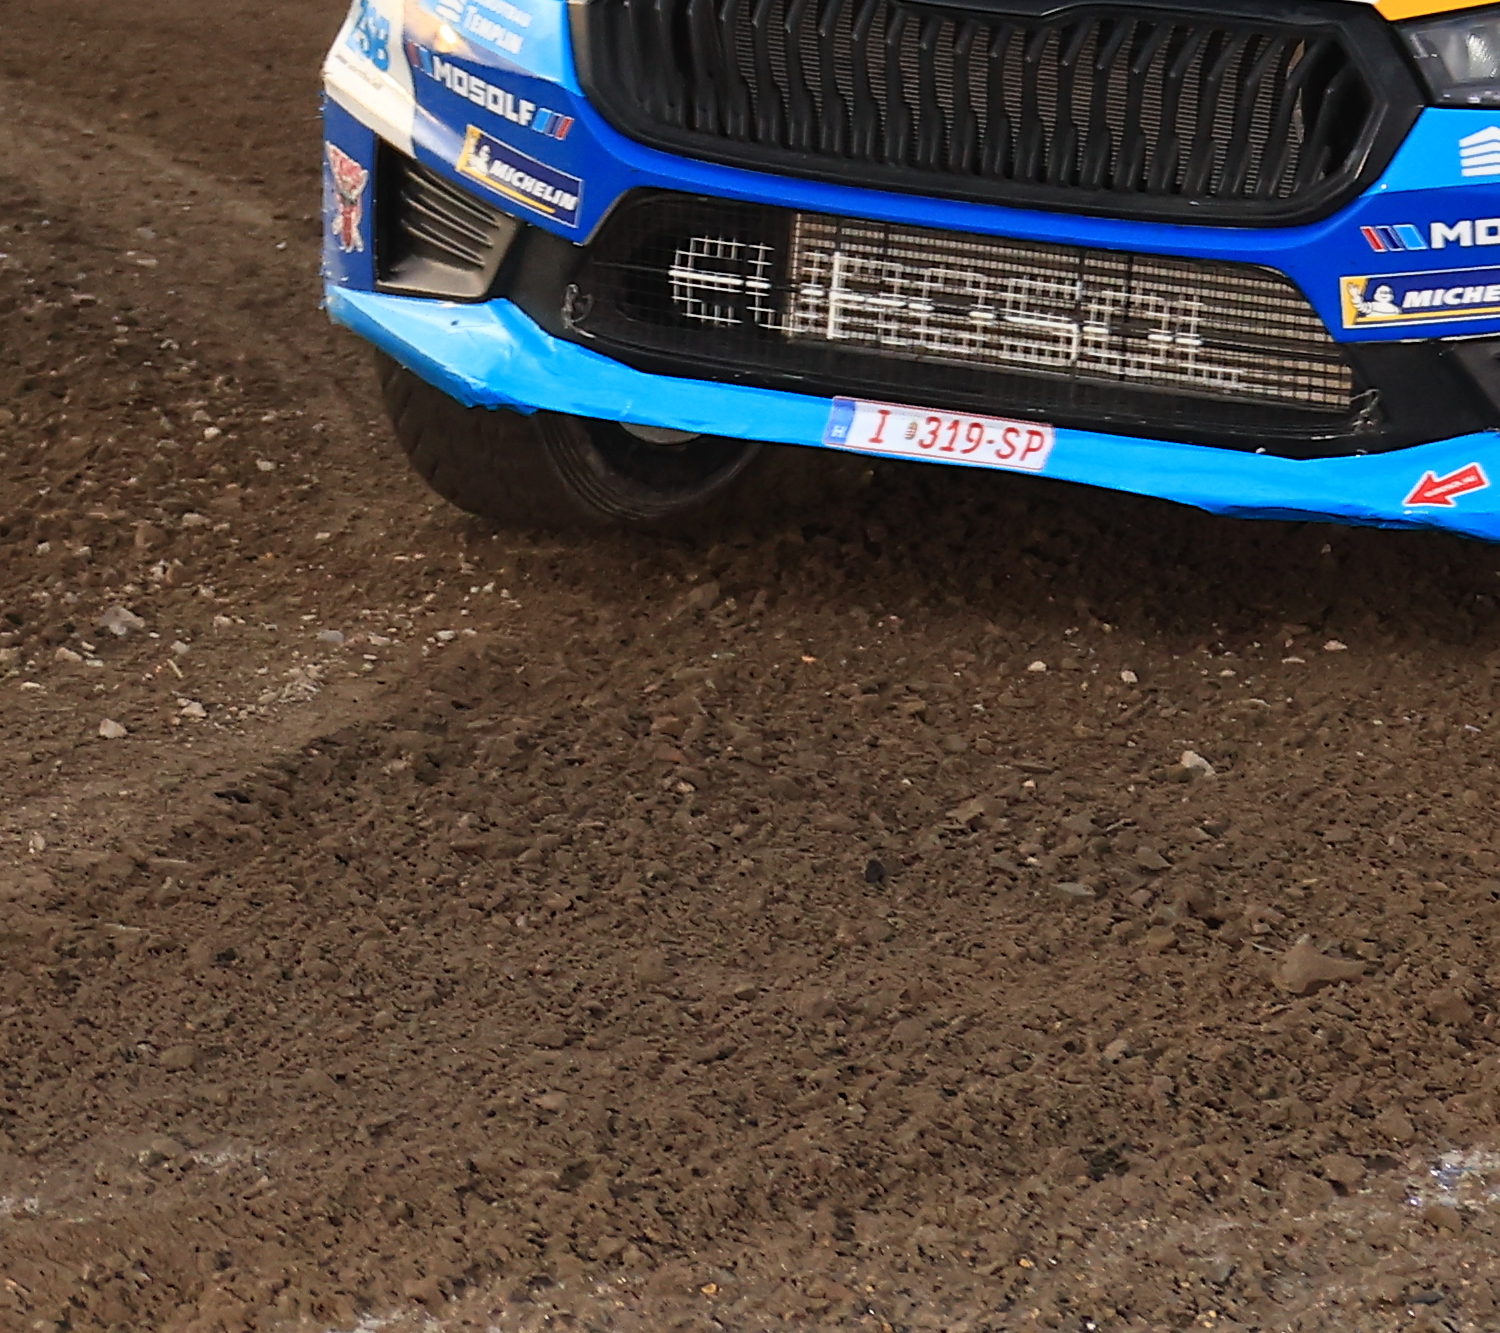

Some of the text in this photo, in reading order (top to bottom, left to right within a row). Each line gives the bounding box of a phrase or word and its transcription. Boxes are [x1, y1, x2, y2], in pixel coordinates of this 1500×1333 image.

[432, 56, 536, 127] MOSOLF
[489, 159, 579, 212] MICHELIN
[917, 416, 1045, 462] 319-SP
